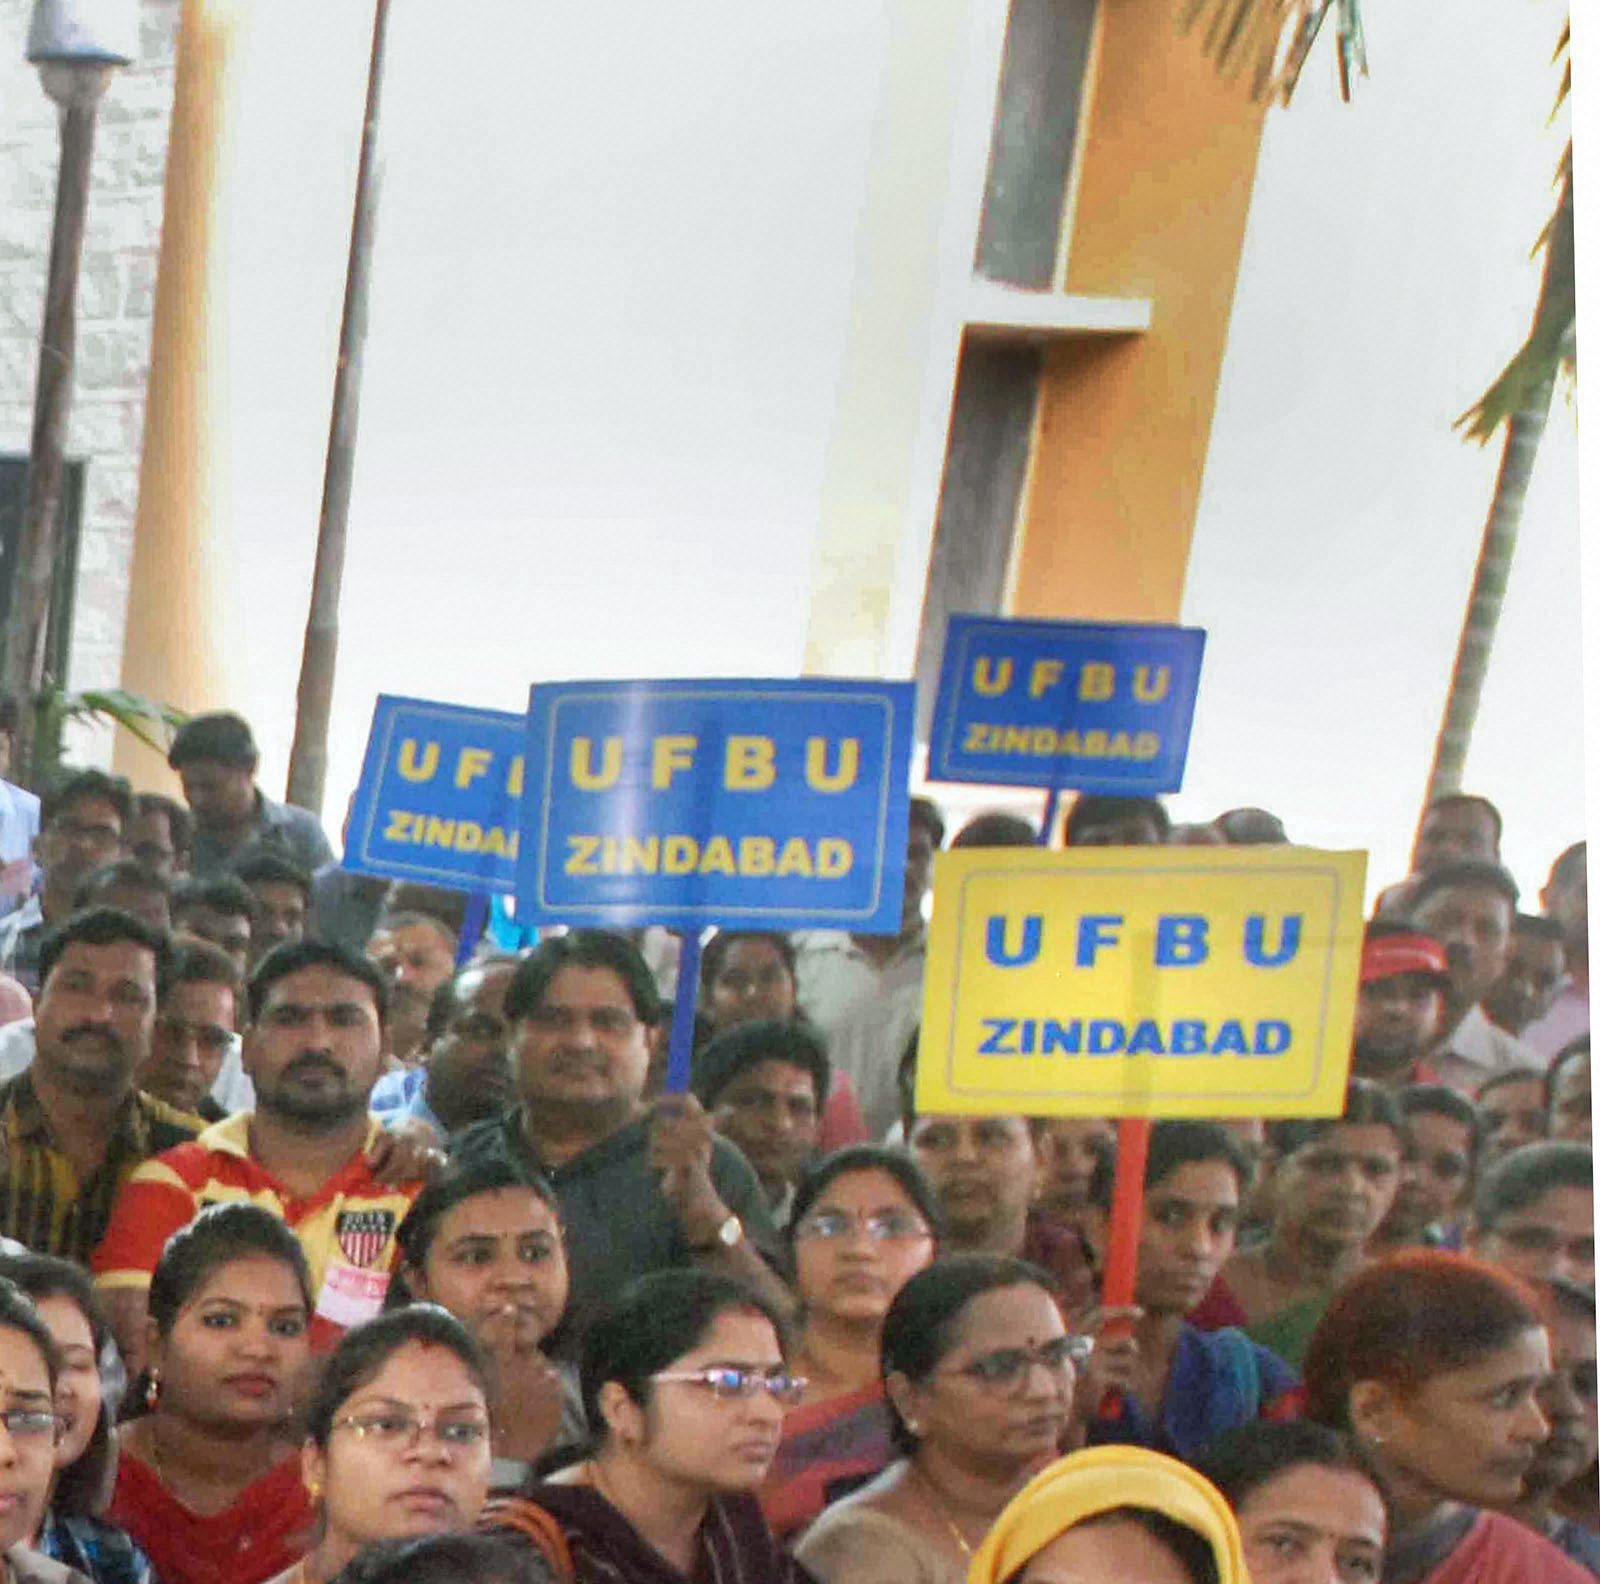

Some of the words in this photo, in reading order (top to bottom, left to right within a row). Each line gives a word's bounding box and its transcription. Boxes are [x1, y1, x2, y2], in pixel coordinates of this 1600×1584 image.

[971, 656, 1170, 702] UFBU
[570, 734, 860, 793] UFBU
[963, 721, 1161, 761] ZINDABAD
[399, 738, 525, 799] UF
[384, 810, 521, 861] ZINDA
[564, 834, 855, 878] ZINDABAD
[984, 913, 1303, 970] UFBU
[977, 1017, 1293, 1059] ZINDABAD
